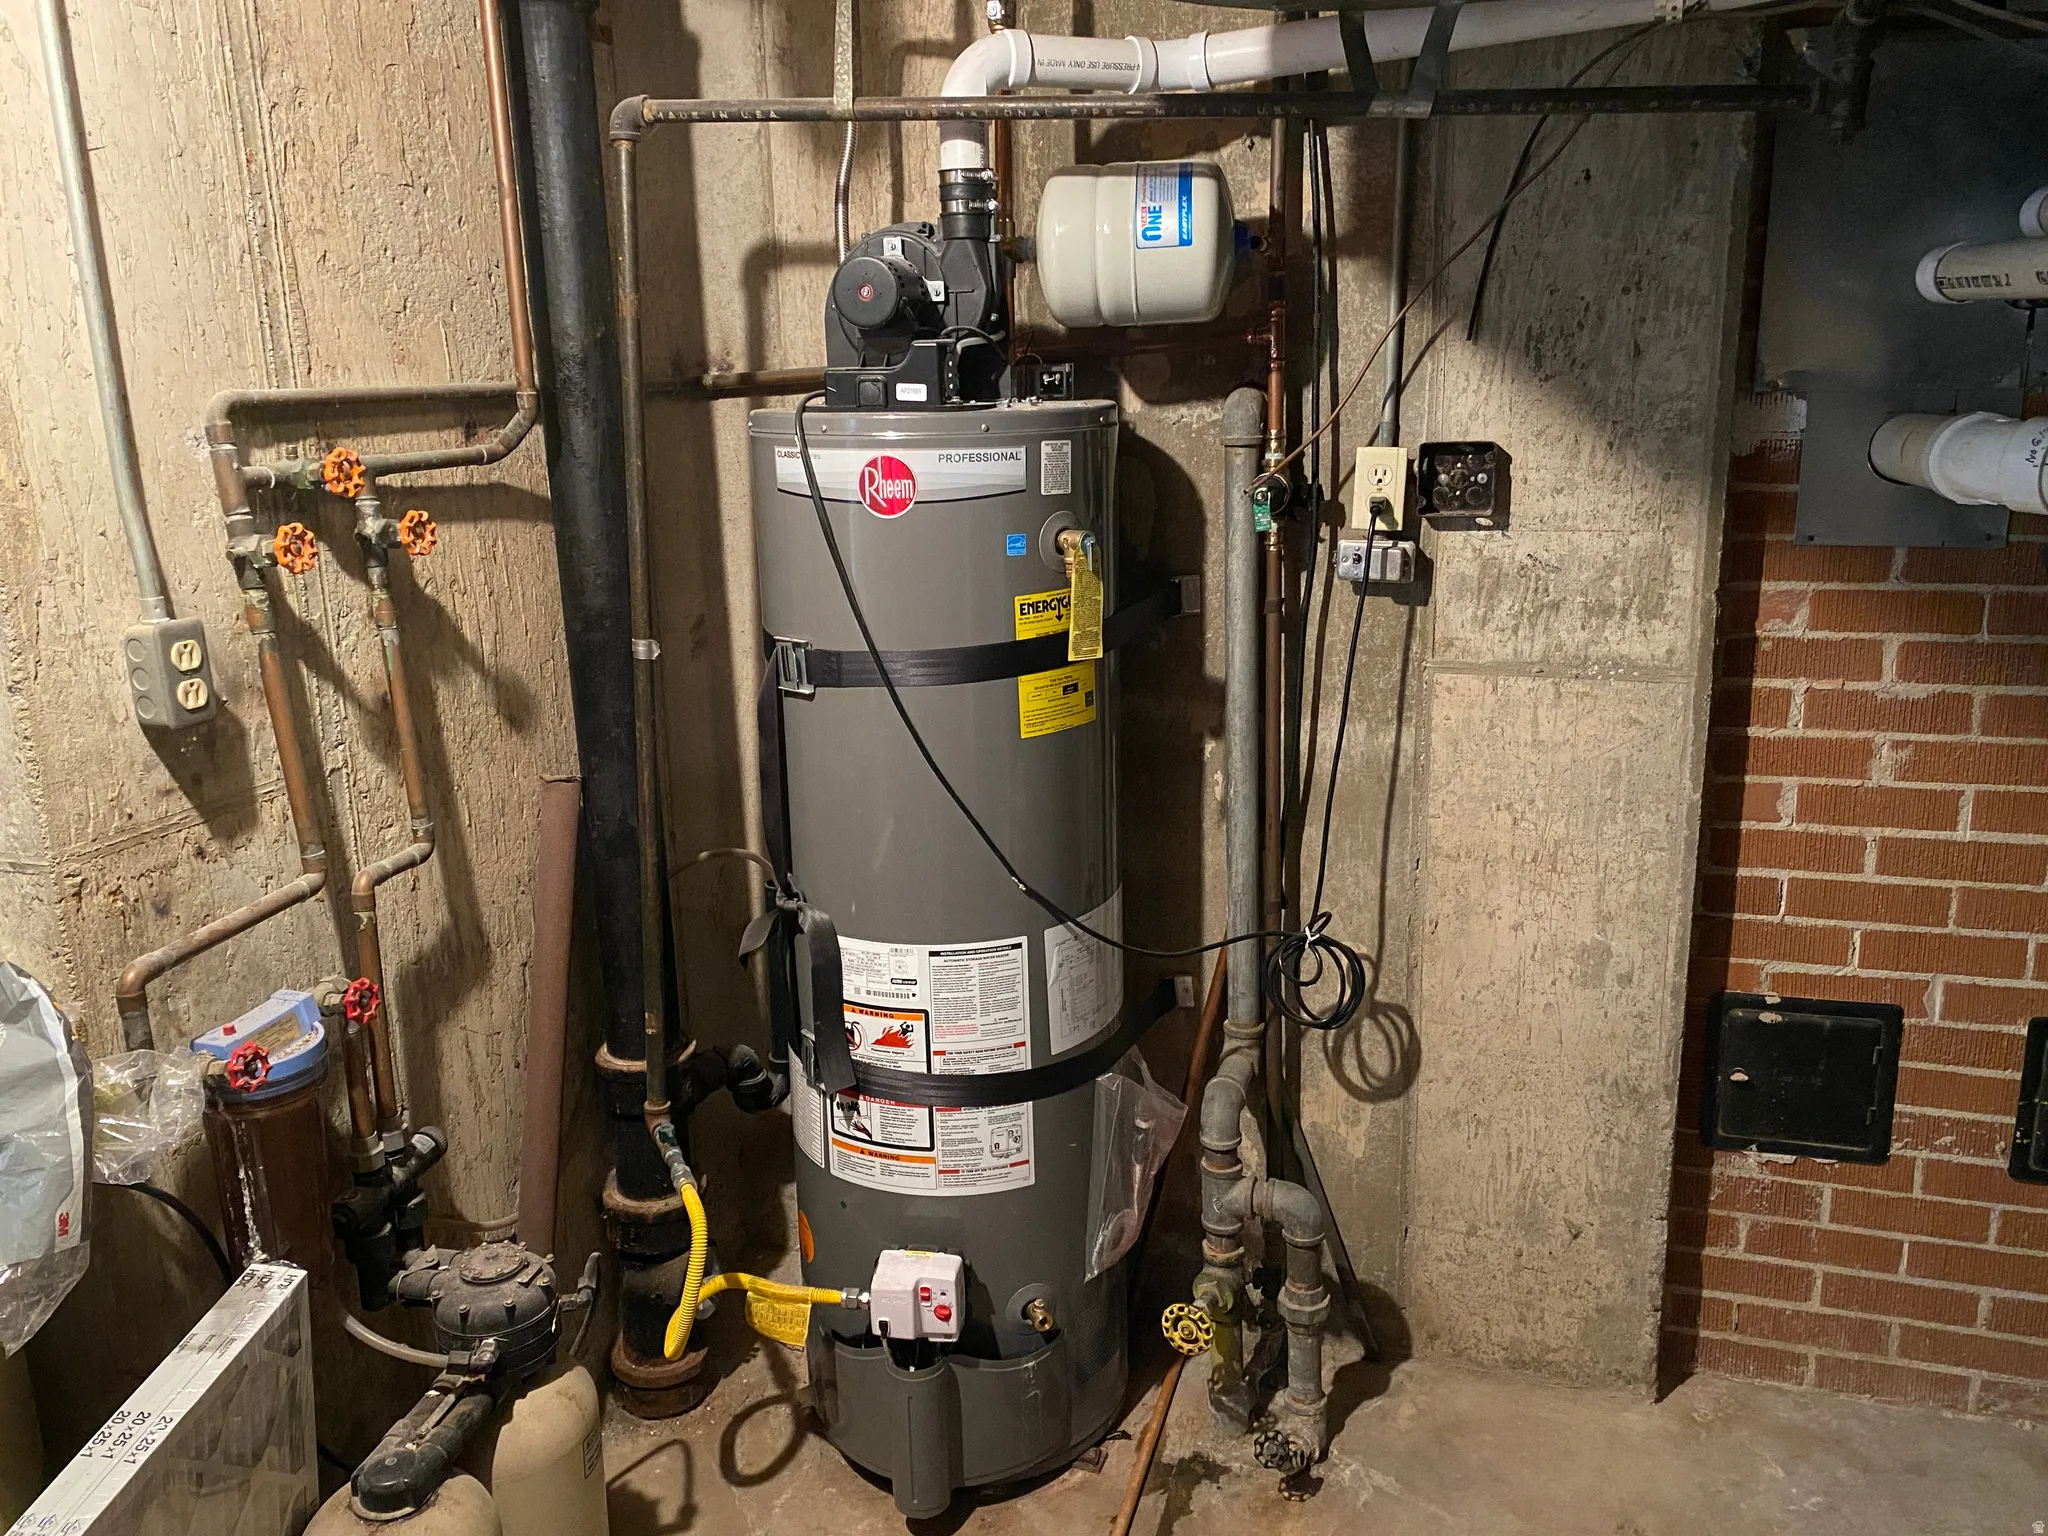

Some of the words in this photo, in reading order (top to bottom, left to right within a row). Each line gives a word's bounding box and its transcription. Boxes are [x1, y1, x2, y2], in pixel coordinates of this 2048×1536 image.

[1046, 58, 1066, 68] MADE
[1068, 60, 1085, 69] ONLY
[1087, 60, 1100, 69] USE
[712, 110, 728, 119] IN
[938, 451, 1022, 463] PROFESSIONAL
[864, 457, 914, 508] Rheem
[859, 1009, 895, 1019] WARNING
[868, 1151, 900, 1161] WARNING
[58, 1211, 69, 1237] 3M
[234, 1268, 260, 1290] HDX
[253, 1270, 276, 1291] HDX
